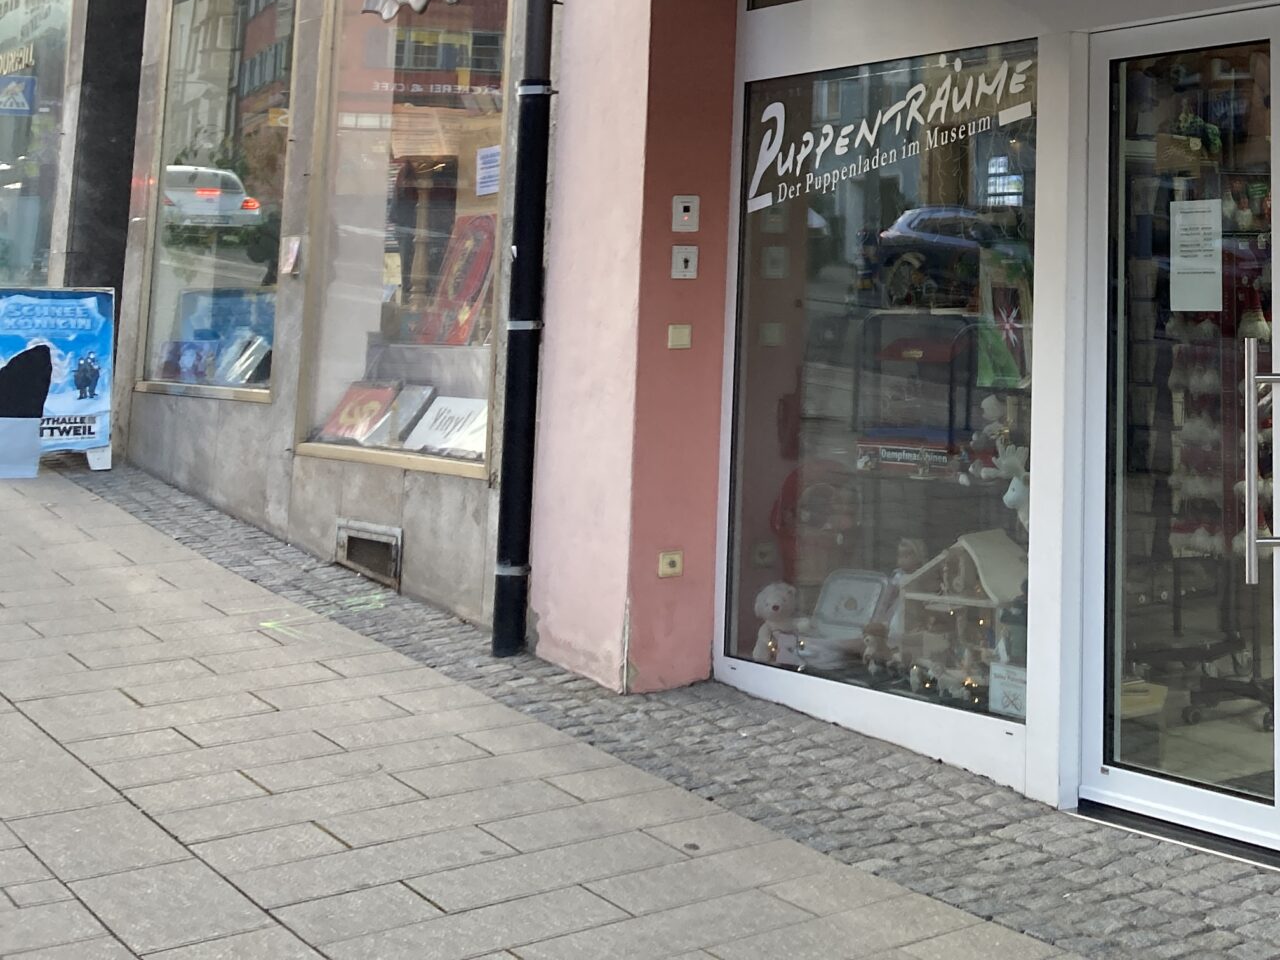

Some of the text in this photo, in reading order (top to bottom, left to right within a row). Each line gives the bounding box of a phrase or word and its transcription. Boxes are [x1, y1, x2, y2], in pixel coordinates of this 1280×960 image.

[777, 114, 992, 203] Der Puppenladen im Museum
[429, 407, 474, 439] Vinyl
[881, 448, 948, 463] Dampfmashinen
